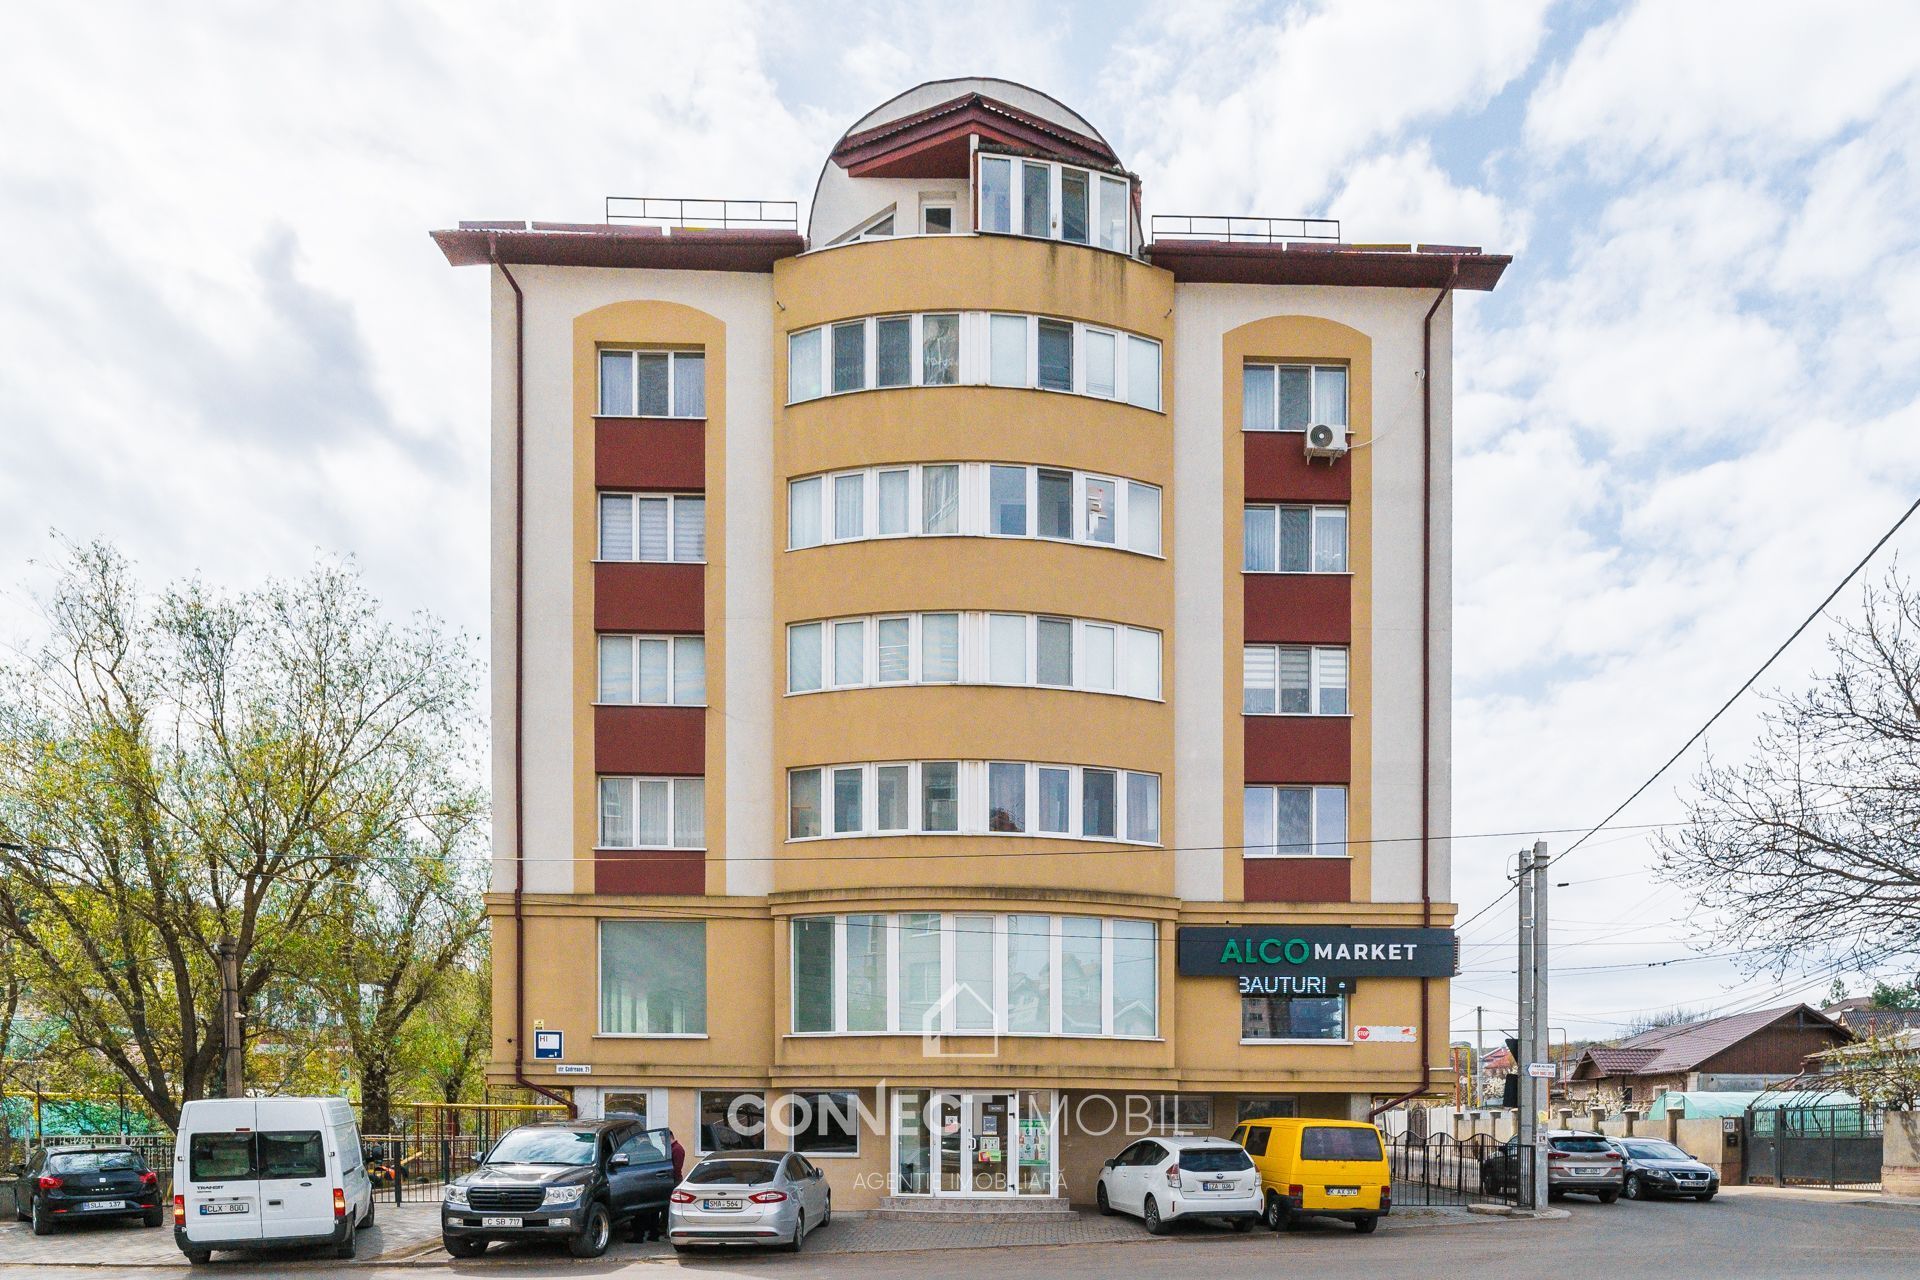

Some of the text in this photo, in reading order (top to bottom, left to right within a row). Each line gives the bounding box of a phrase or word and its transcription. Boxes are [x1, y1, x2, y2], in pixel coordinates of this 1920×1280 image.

[1220, 938, 1417, 965] ALCO MARKET
[1239, 976, 1327, 994] BAUTURI
[1724, 1121, 1734, 1130] 20
[709, 1200, 722, 1208] SMA
[207, 1205, 223, 1213] CLX
